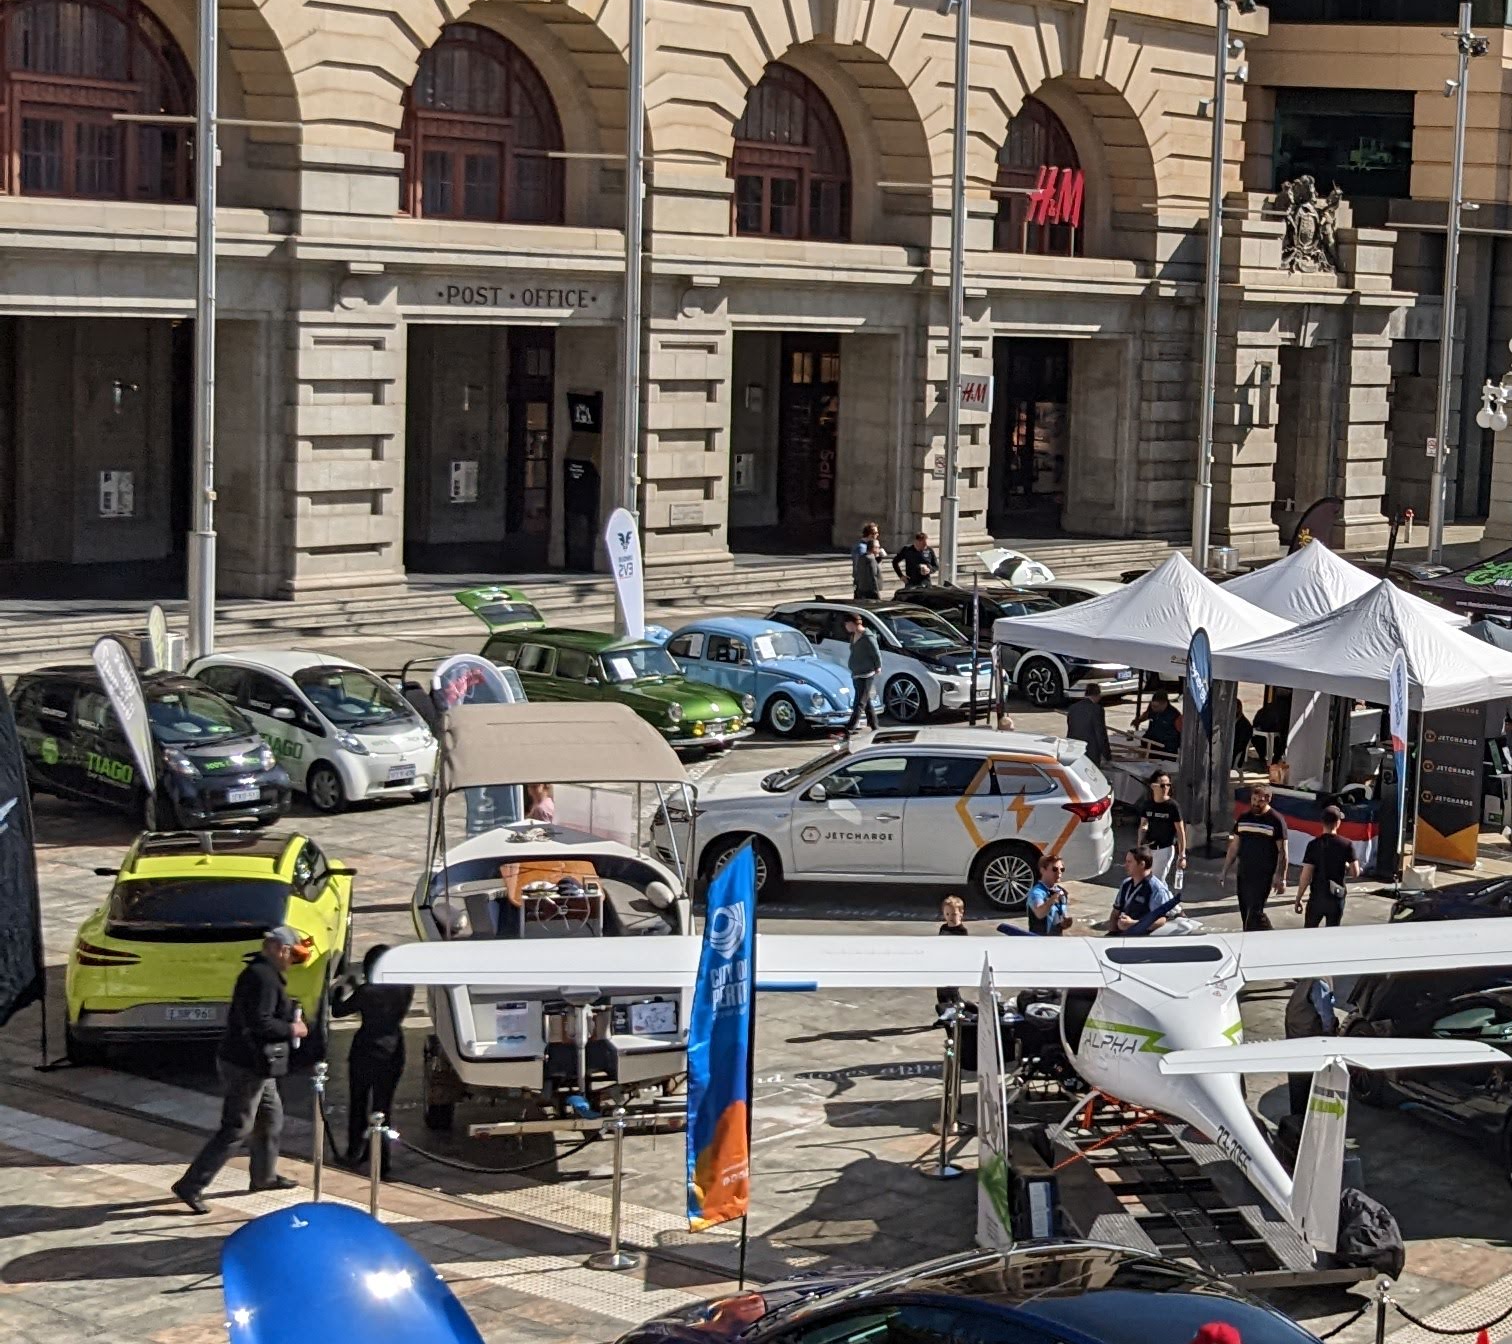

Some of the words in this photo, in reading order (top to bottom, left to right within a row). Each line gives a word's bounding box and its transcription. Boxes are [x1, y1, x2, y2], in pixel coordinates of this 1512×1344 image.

[1025, 164, 1086, 229] H&M
[446, 284, 503, 306] POST
[521, 287, 591, 308] OFFICE
[961, 381, 988, 404] H&M
[1437, 734, 1478, 746] JETCHARGE
[87, 751, 134, 785] TIAGO
[1436, 764, 1476, 776] JETCHARGE
[1434, 794, 1474, 807] JETCHARGE
[824, 831, 894, 842] JETCHARGE
[710, 961, 733, 989] CITY
